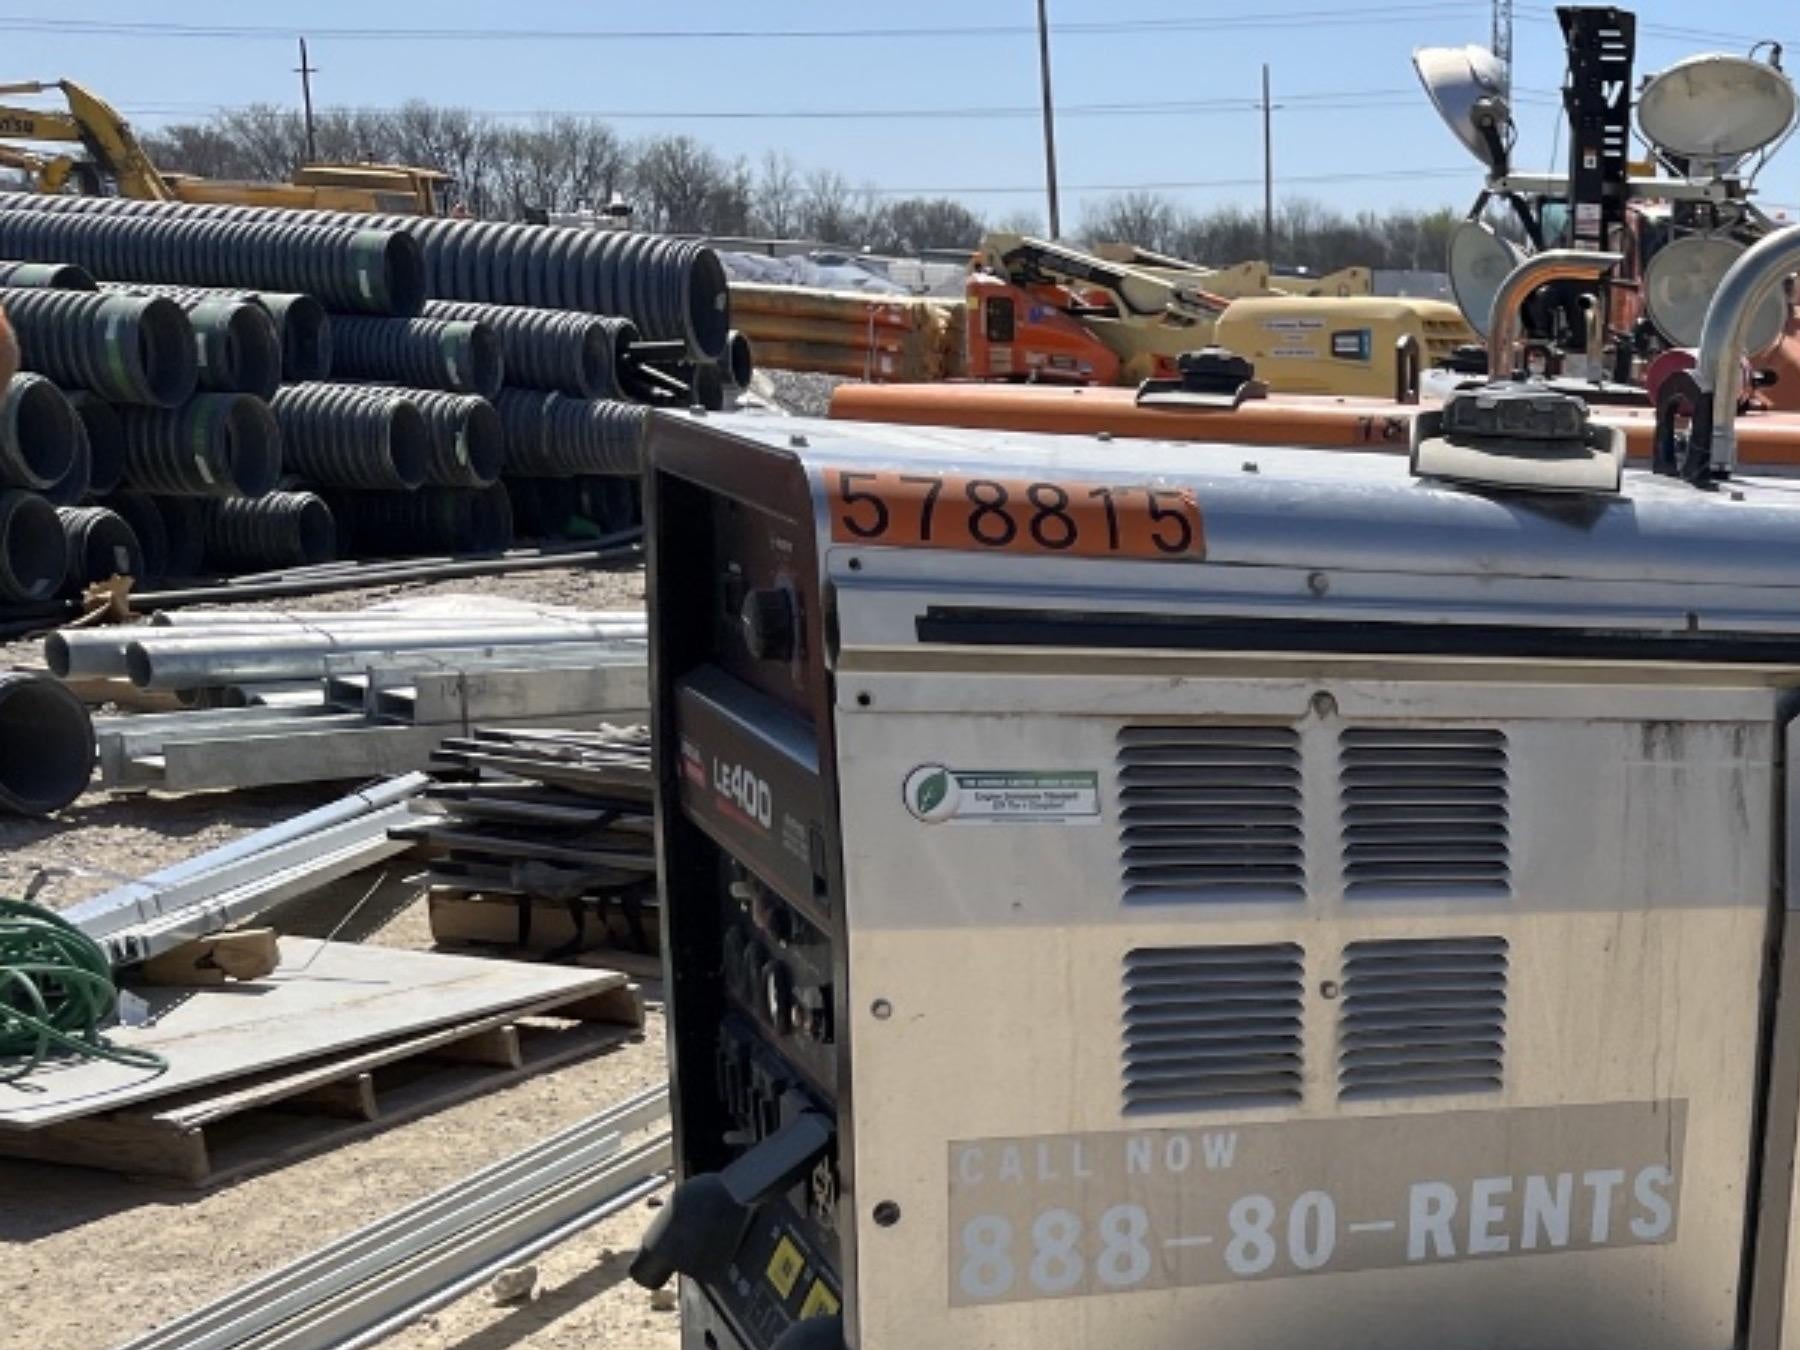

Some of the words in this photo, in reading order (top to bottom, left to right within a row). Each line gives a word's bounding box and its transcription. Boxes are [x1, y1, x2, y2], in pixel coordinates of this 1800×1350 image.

[839, 471, 1193, 553] 578815
[957, 1140, 1092, 1186] CALL
[1126, 1131, 1239, 1175] NOW
[957, 1164, 1674, 1299] 888-80-RENTS
